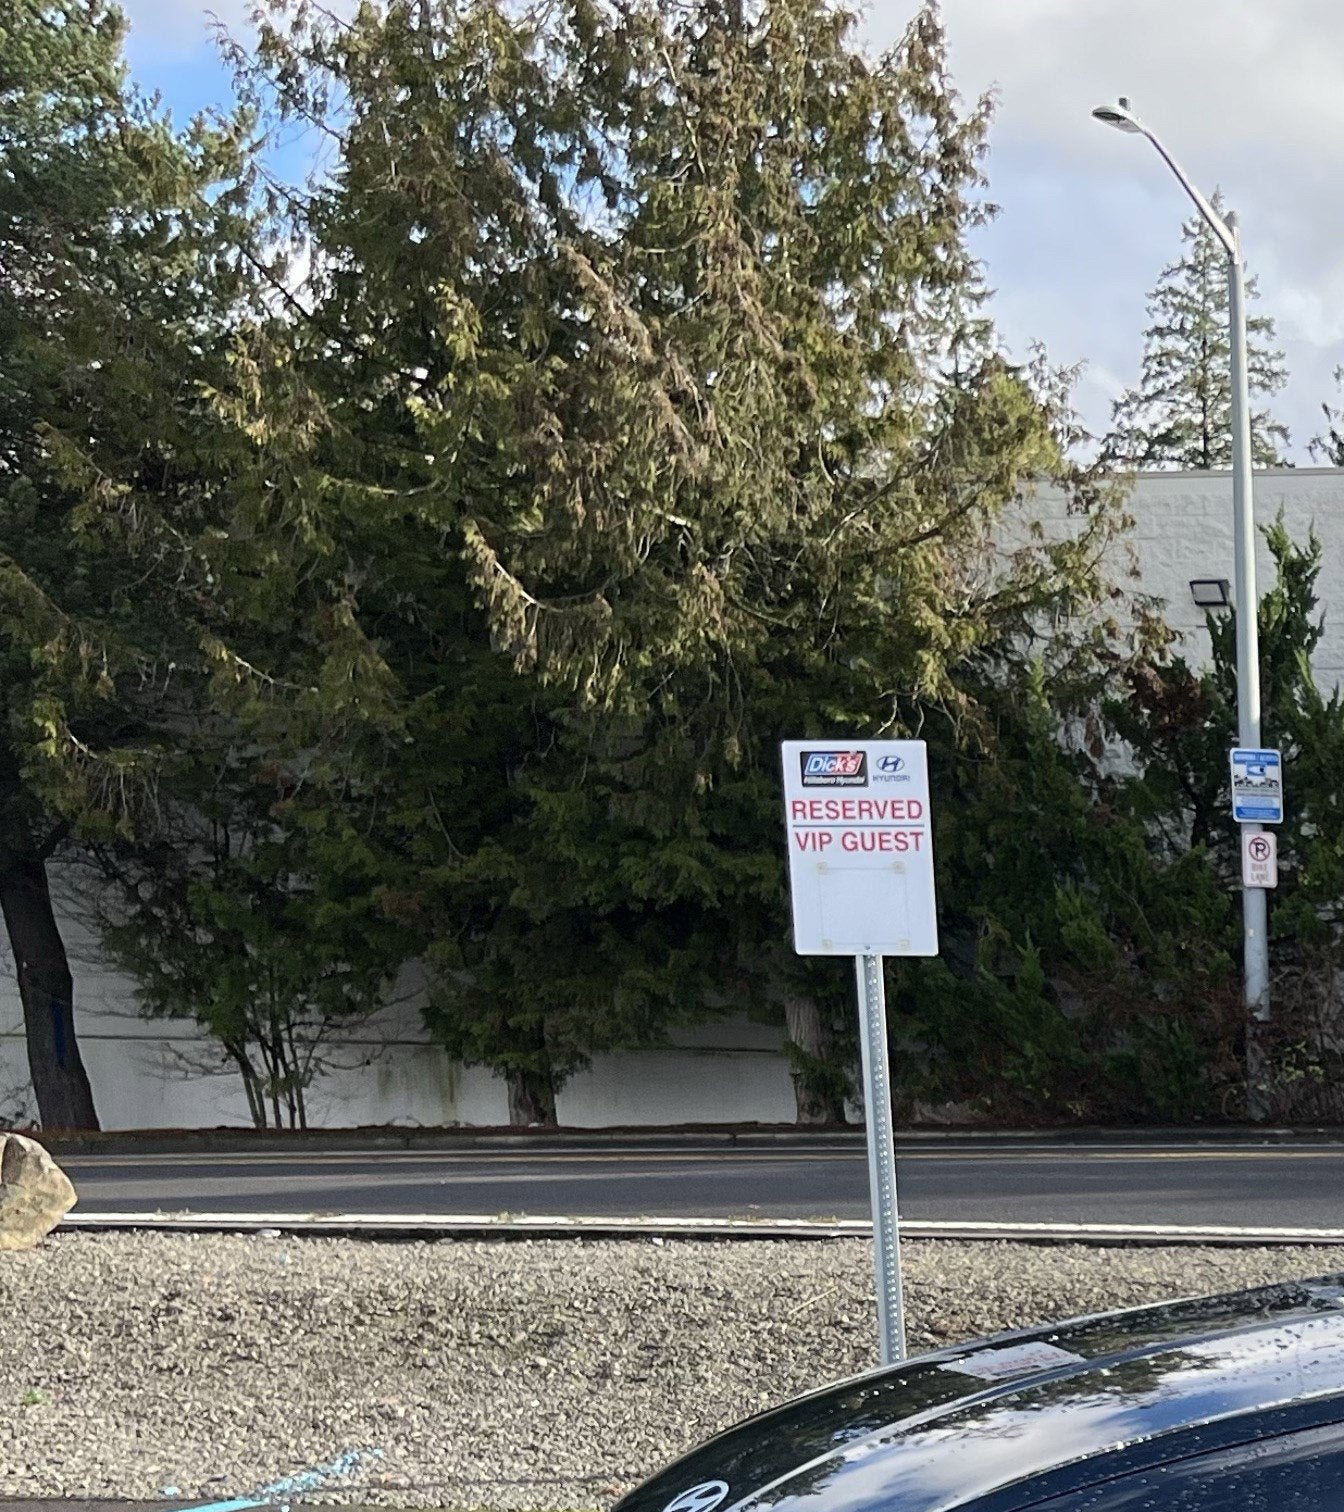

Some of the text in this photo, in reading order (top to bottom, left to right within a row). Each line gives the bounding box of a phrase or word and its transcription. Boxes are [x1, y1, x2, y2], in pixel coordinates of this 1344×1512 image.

[791, 799, 923, 820] RESERVED
[795, 832, 924, 852] VIP GUEST
